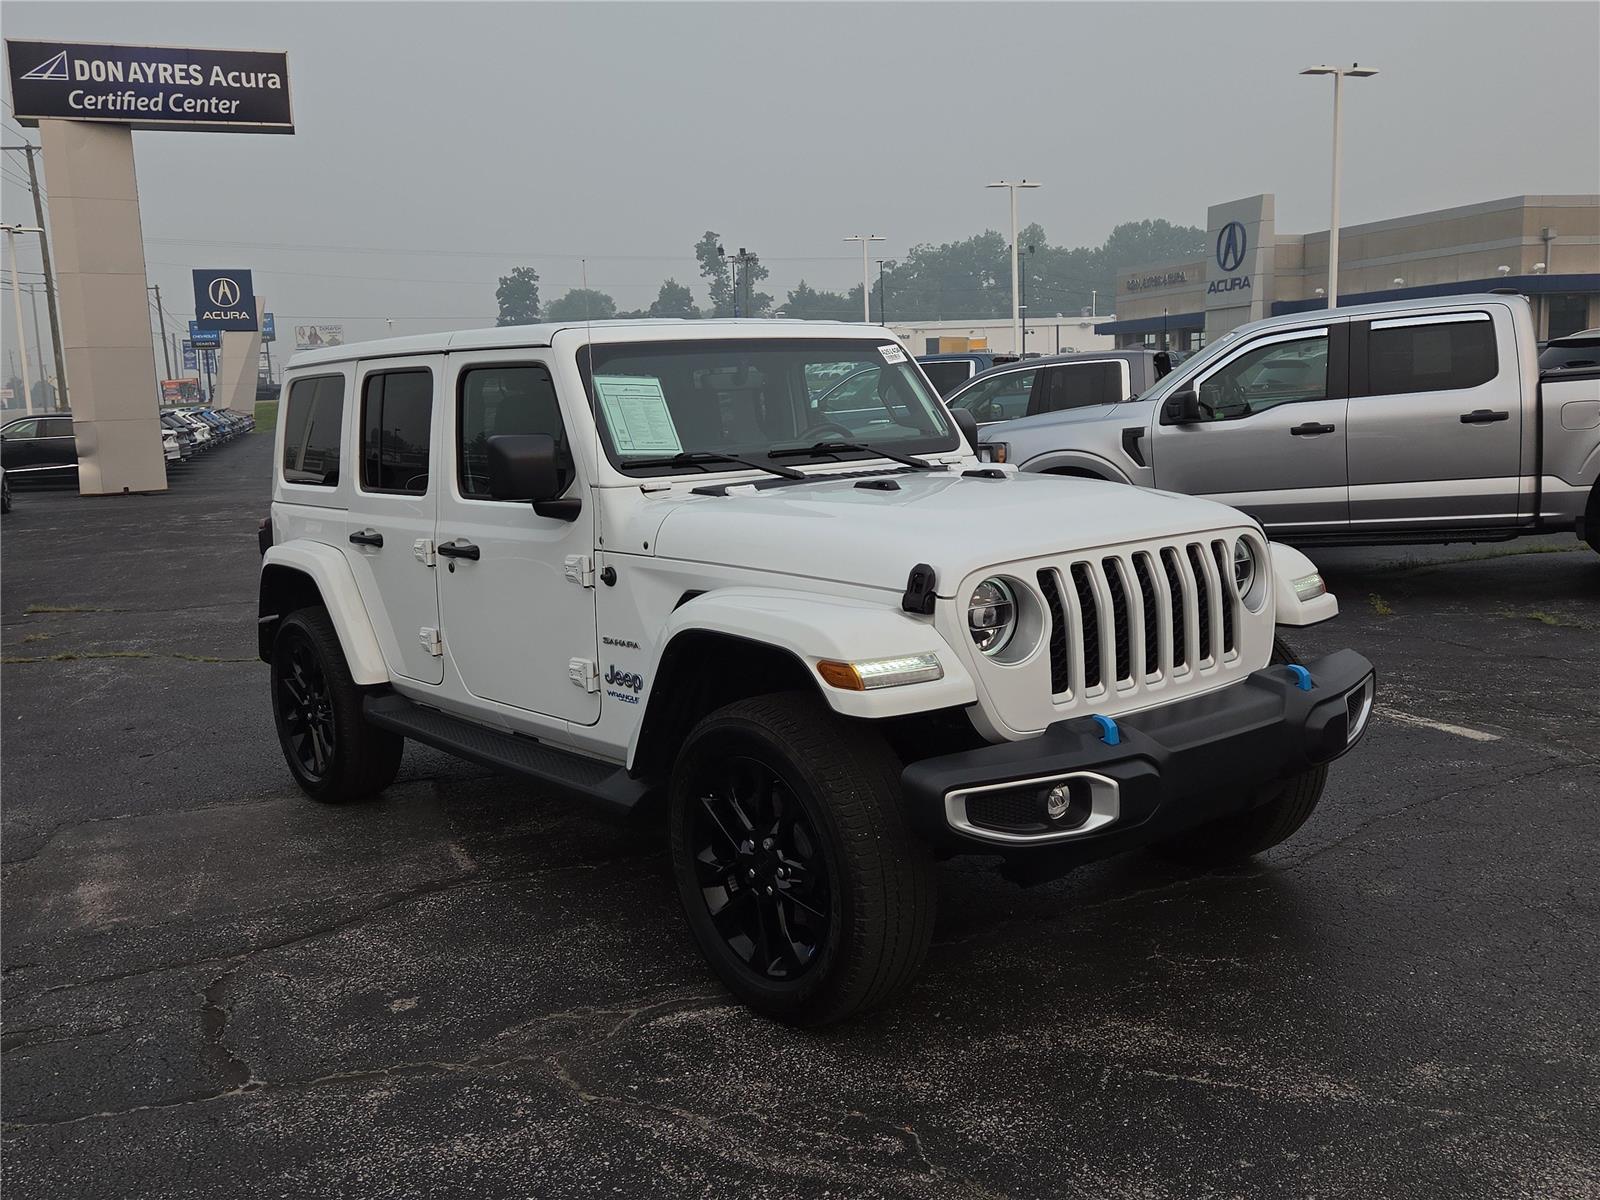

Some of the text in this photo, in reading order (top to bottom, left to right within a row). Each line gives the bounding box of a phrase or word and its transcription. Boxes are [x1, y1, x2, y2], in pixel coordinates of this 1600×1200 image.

[73, 59, 281, 89] DON AYRES Acura
[68, 90, 240, 114] Certified Center
[1207, 276, 1251, 294] ACURA
[202, 311, 250, 320] ACURA
[602, 637, 640, 649] SAHARA
[604, 664, 644, 694] Jeep
